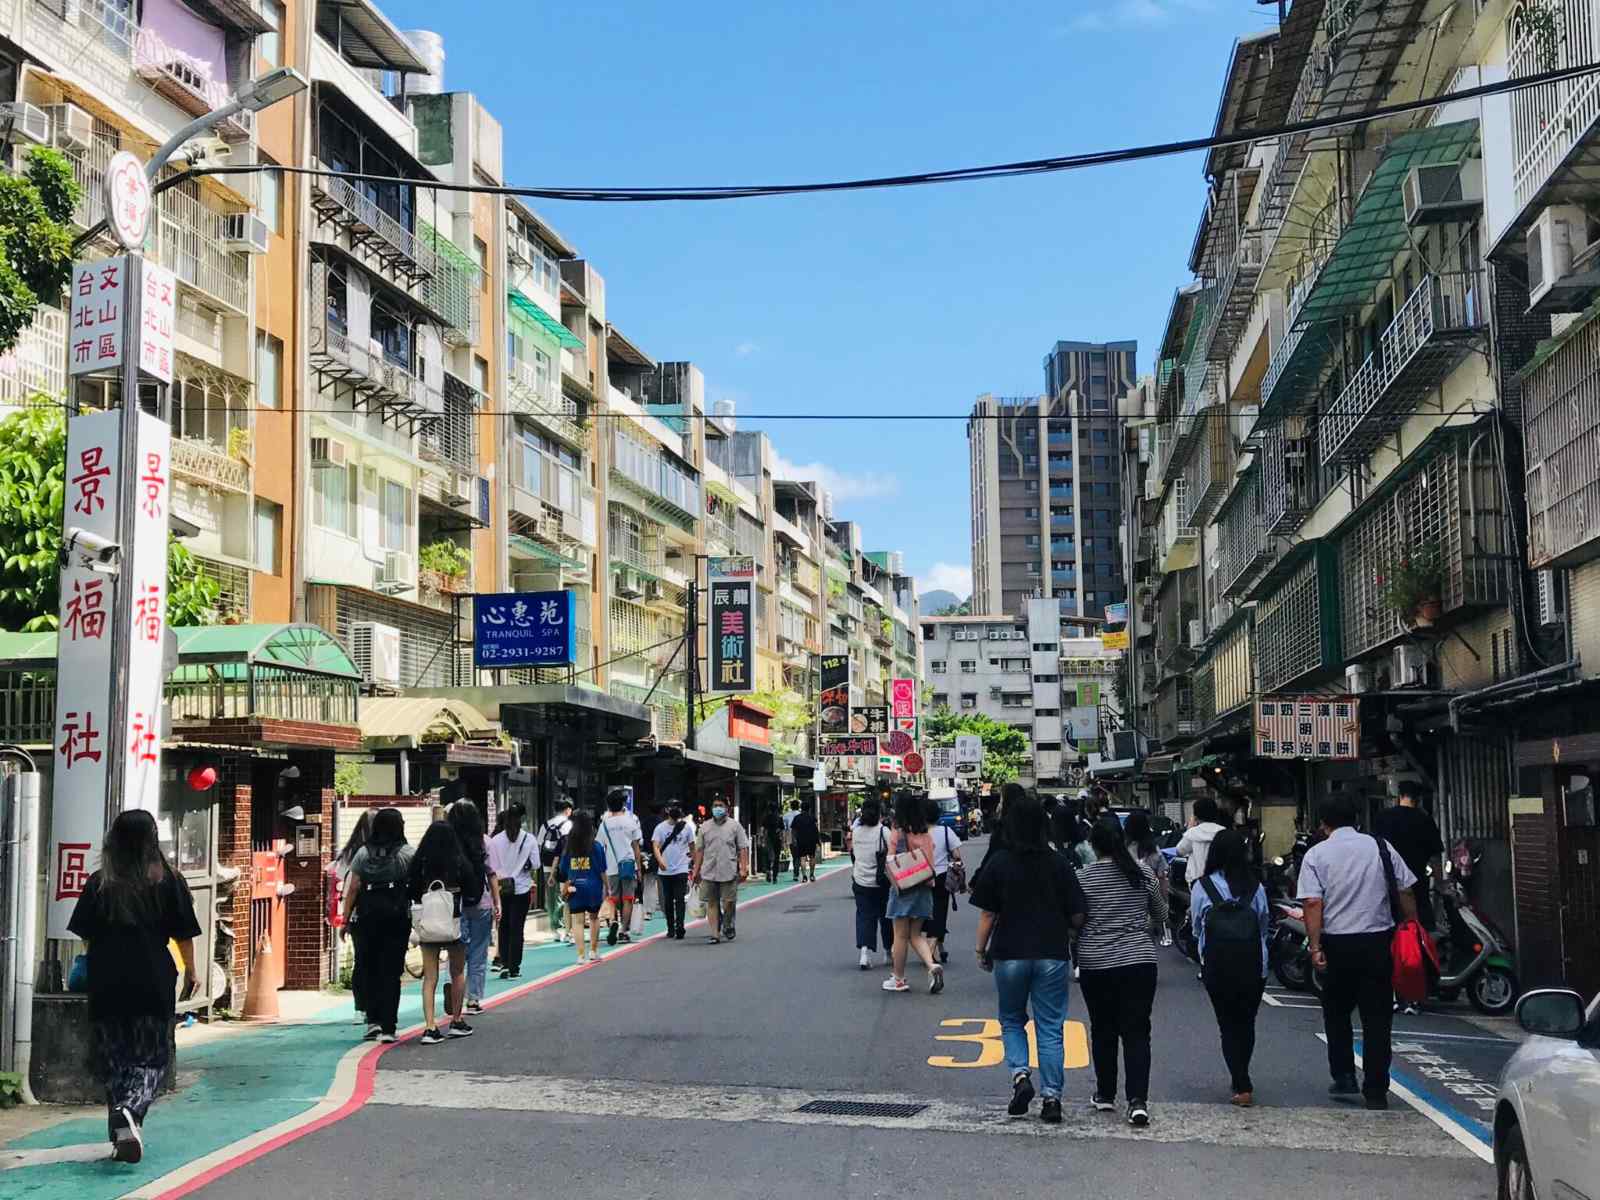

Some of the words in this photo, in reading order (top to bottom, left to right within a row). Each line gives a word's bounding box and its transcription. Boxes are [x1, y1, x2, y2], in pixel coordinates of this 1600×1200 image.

[73, 270, 94, 362] 台北市
[98, 265, 119, 360] 文山區
[144, 271, 157, 362] 台北市
[160, 283, 172, 375] 文山區
[481, 646, 563, 658] 02-2931-9287
[486, 630, 534, 639] TRANQUIL
[542, 628, 560, 637] SPA
[721, 611, 744, 683] 美術社
[55, 446, 111, 902] 景福社區
[1281, 704, 1294, 753] 奶茶
[1299, 704, 1312, 753] 三明治
[927, 1018, 1090, 1068] 30
